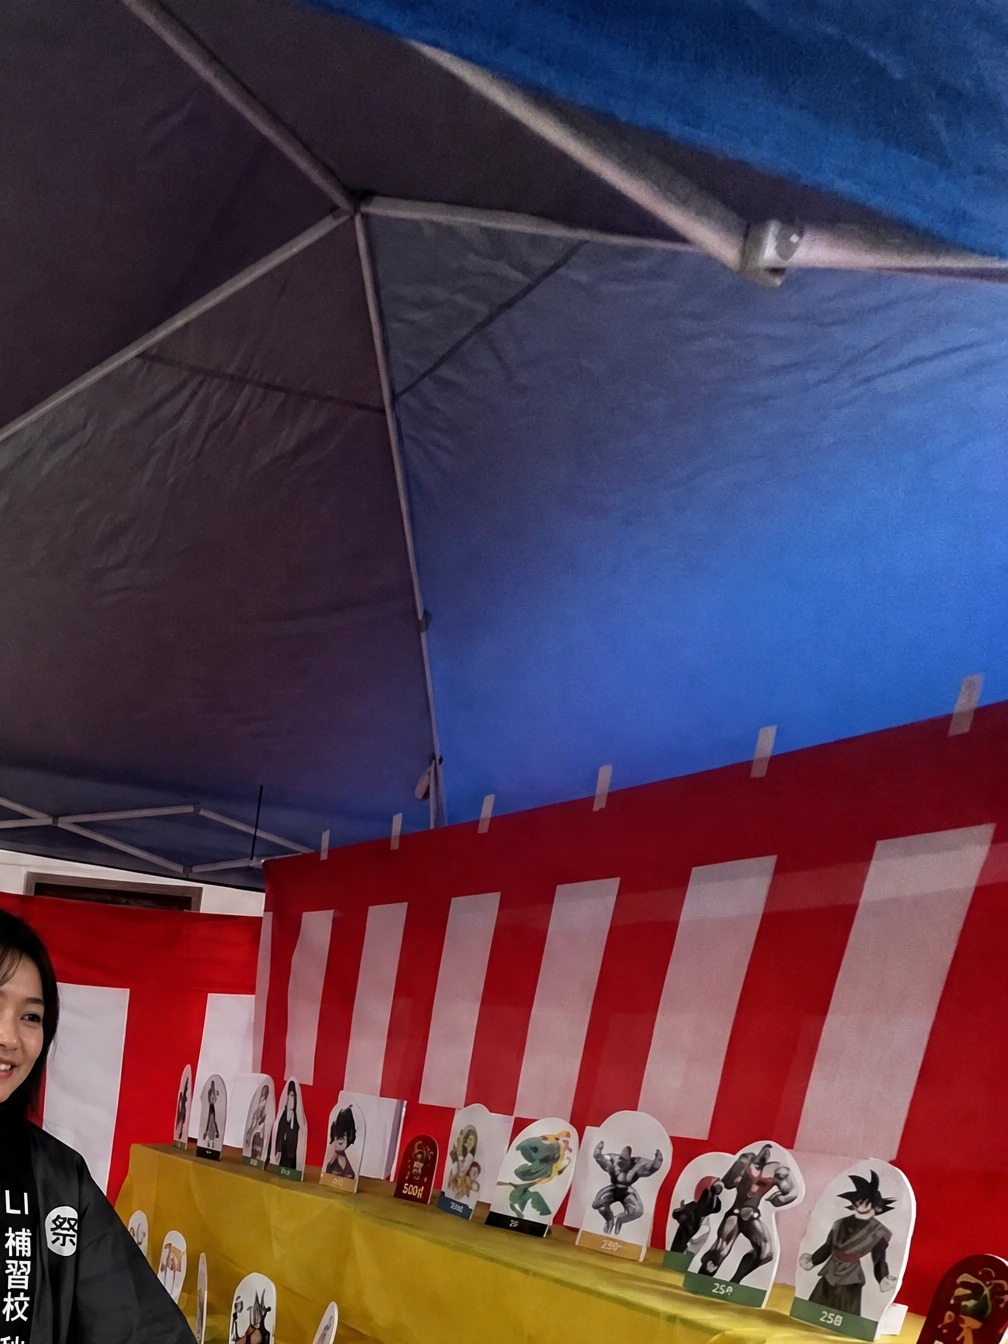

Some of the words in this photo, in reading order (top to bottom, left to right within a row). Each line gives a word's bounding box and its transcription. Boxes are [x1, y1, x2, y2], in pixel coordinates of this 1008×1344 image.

[50, 1213, 79, 1247] 祭
[1, 1226, 32, 1322] 補習校
